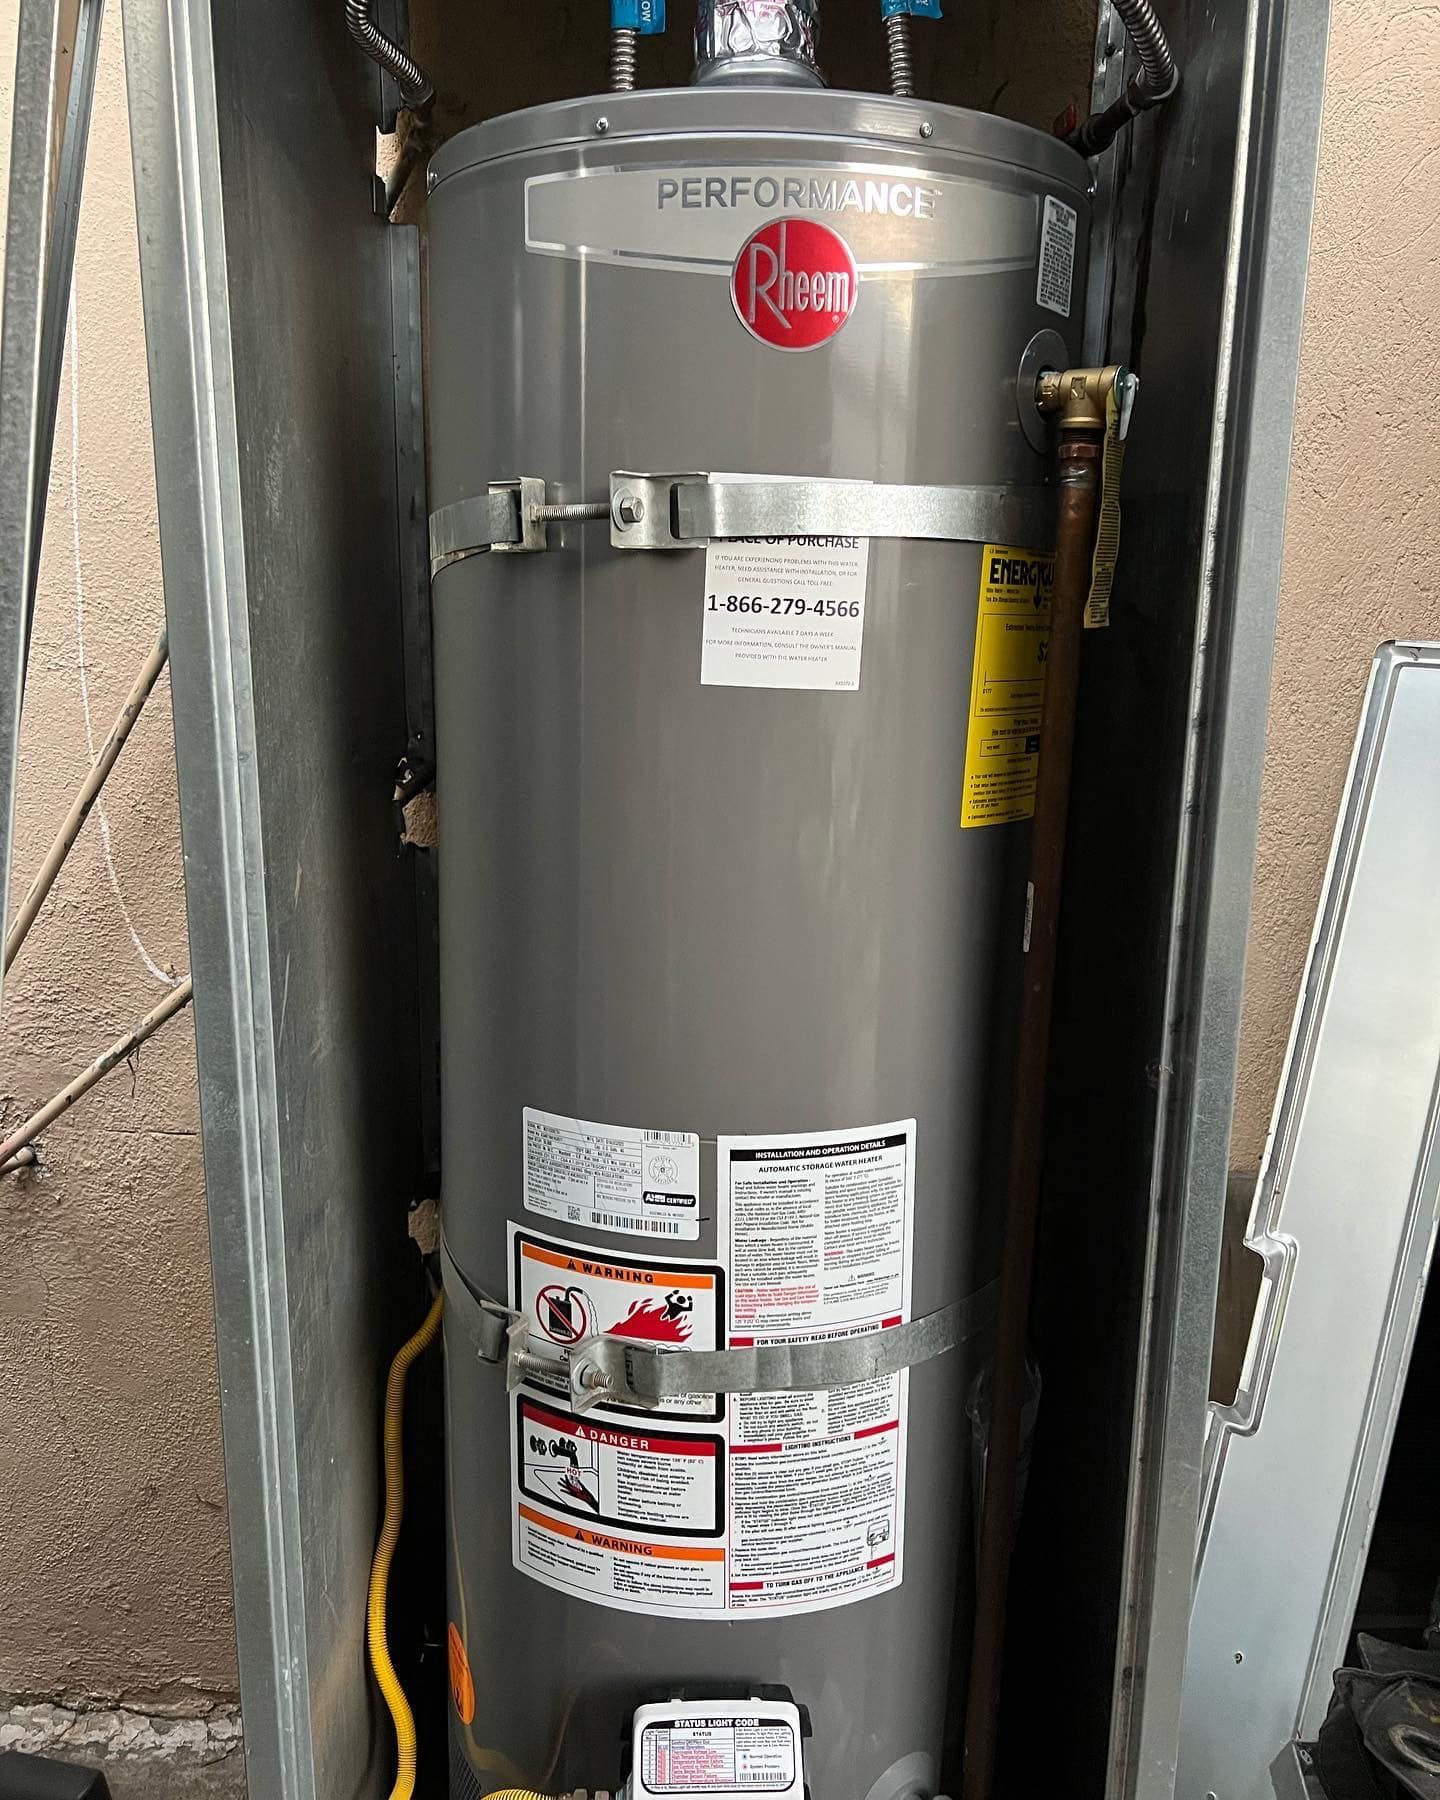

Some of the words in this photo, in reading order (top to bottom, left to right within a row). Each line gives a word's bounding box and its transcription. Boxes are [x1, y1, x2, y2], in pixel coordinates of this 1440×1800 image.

[640, 0, 652, 22] OW
[657, 176, 935, 219] PERFORMANCE
[748, 221, 850, 330] Rheem
[787, 536, 859, 549] PURCHASE
[708, 595, 859, 617] 1-866-279-4566
[755, 1150, 804, 1159] INSTALLATION
[805, 1149, 820, 1157] AND
[822, 1145, 860, 1155] OPERATION
[861, 1140, 886, 1150] DETAILS
[759, 1164, 800, 1173] AUTOMATIC
[801, 1162, 833, 1171] STORAGE
[835, 1159, 858, 1168] WATER
[858, 1155, 883, 1165] HEATER
[582, 1262, 655, 1284] WARNING
[788, 1336, 809, 1345] SAFETY
[811, 1334, 826, 1342] READ
[827, 1331, 849, 1340] BEFORE
[850, 1324, 879, 1336] OPERATING
[590, 1430, 648, 1450] DANGER
[785, 1442, 811, 1451] LIGHTING
[812, 1435, 851, 1448] INSTRUCTIONS
[567, 1467, 581, 1477] HOT
[591, 1534, 653, 1556] WARNING
[836, 1566, 864, 1578] APPLIANCE
[708, 1719, 733, 1727] LIGHT
